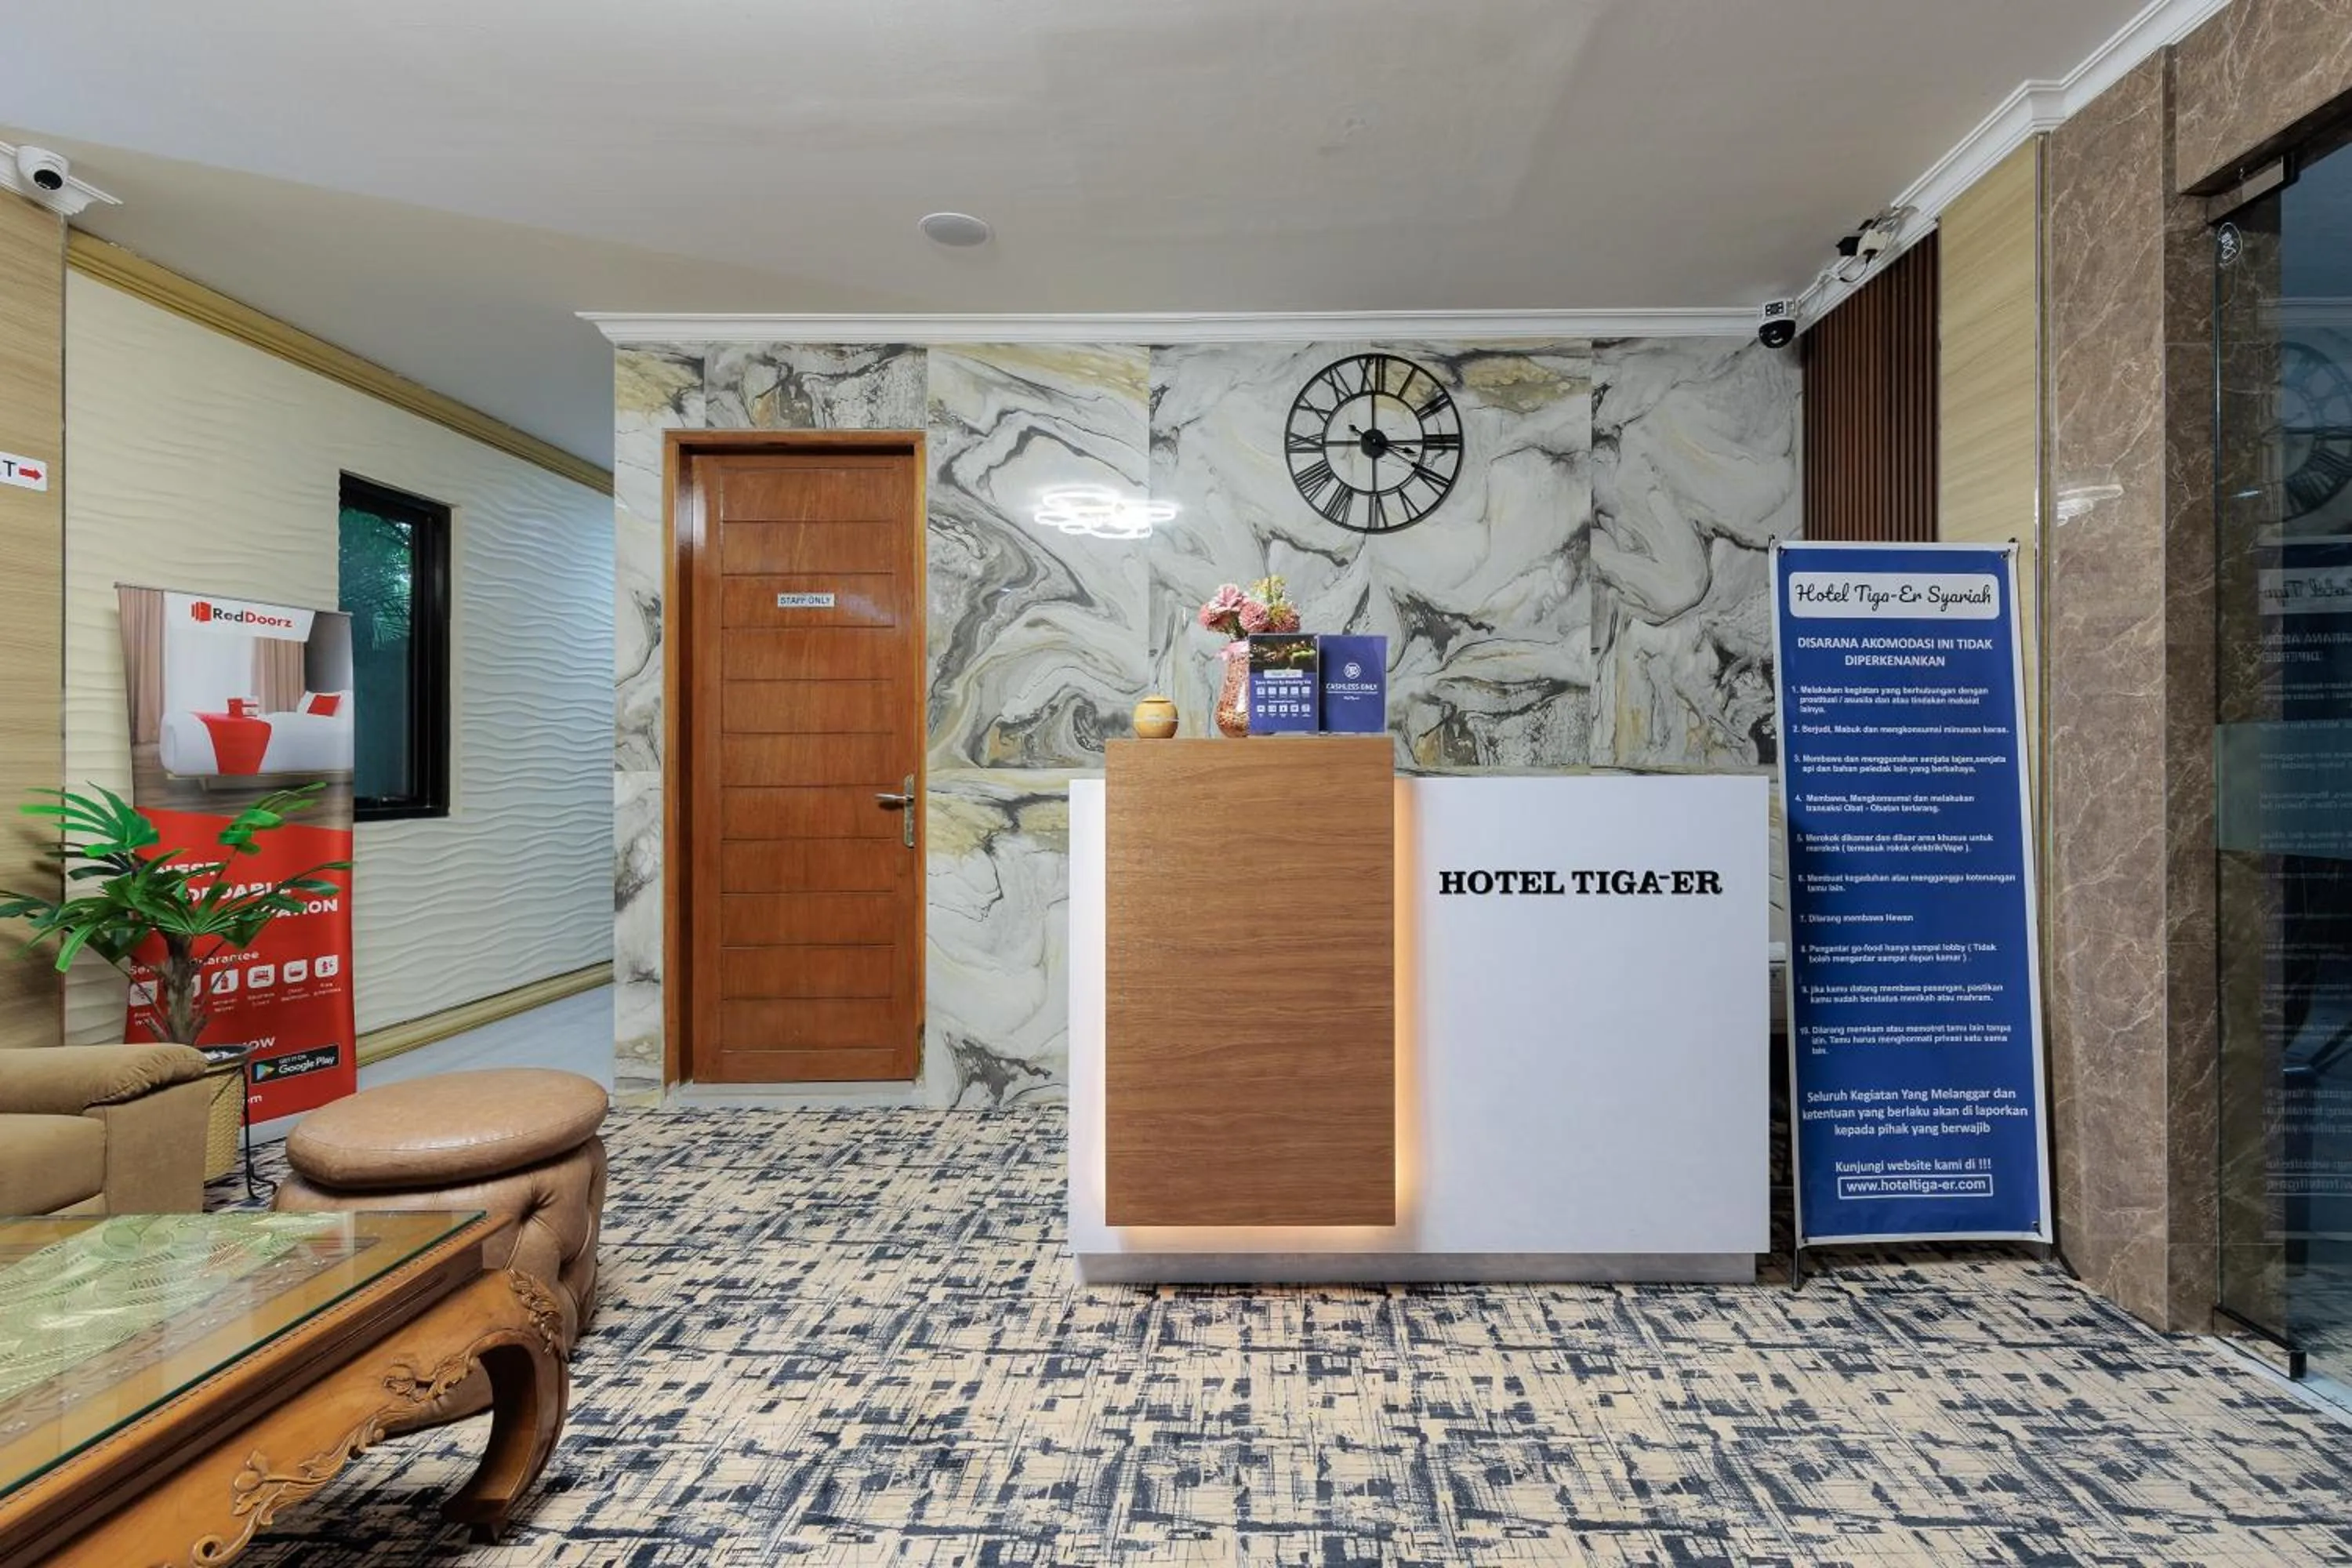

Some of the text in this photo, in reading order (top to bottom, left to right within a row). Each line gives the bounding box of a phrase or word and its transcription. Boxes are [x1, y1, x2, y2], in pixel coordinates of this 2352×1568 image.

[808, 596, 830, 604] ONLY
[1795, 583, 1991, 612] Hotel Tiga-Er Syariah
[213, 608, 292, 627] RedDoorz
[1798, 637, 1993, 650] DISARANA AKOMODASI INI TIDAK
[1845, 655, 1946, 666] DIPERKENANKAN
[1844, 686, 1879, 695] kegiatan
[1881, 687, 1900, 695] yang
[1903, 687, 1956, 696] berhubungan
[1958, 687, 1989, 696] dengan
[1439, 871, 1565, 895] HOTEL
[279, 1056, 335, 1073] Google Play
[1807, 1088, 2016, 1102] Seluruh Kegiatan Yang Melanggar dan
[1803, 1105, 2028, 1120] ketentuan yang berlaku akan di laporkan
[1835, 1121, 1991, 1138] kepada pihak yang berwajib
[1835, 1160, 1884, 1173] Kunjungi
[1887, 1160, 1932, 1171] website
[1934, 1160, 1962, 1170] kami
[1965, 1159, 1976, 1170] di
[1846, 1178, 1986, 1192] www.hoteltiga-er.com
